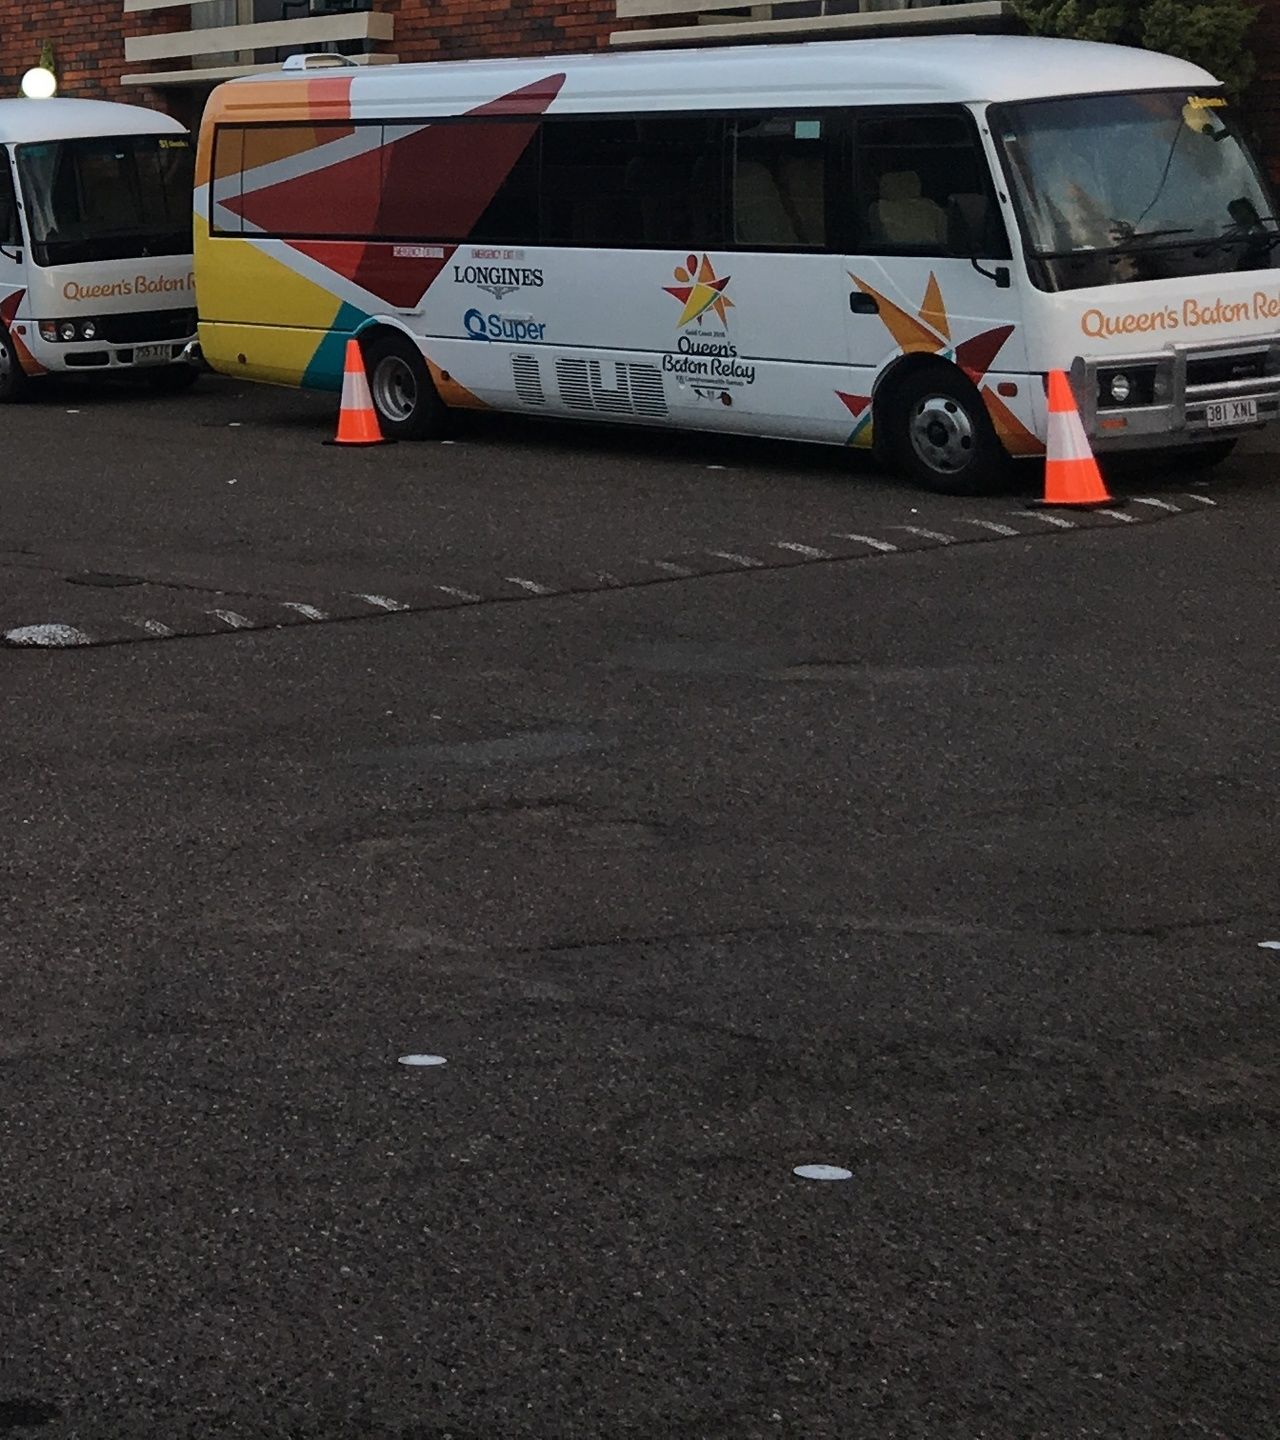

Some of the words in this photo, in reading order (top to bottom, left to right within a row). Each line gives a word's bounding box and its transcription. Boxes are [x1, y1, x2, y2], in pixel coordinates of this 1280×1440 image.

[63, 279, 132, 302] Queen's
[134, 274, 184, 294] Baton
[454, 265, 544, 288] LONGINES
[1081, 304, 1179, 340] Queen's
[1183, 297, 1250, 327] Baton
[677, 335, 738, 357] Queen's
[662, 354, 708, 375] Baton
[711, 357, 755, 385] Relay
[1208, 405, 1228, 422] 381
[1232, 400, 1255, 419] XNL
